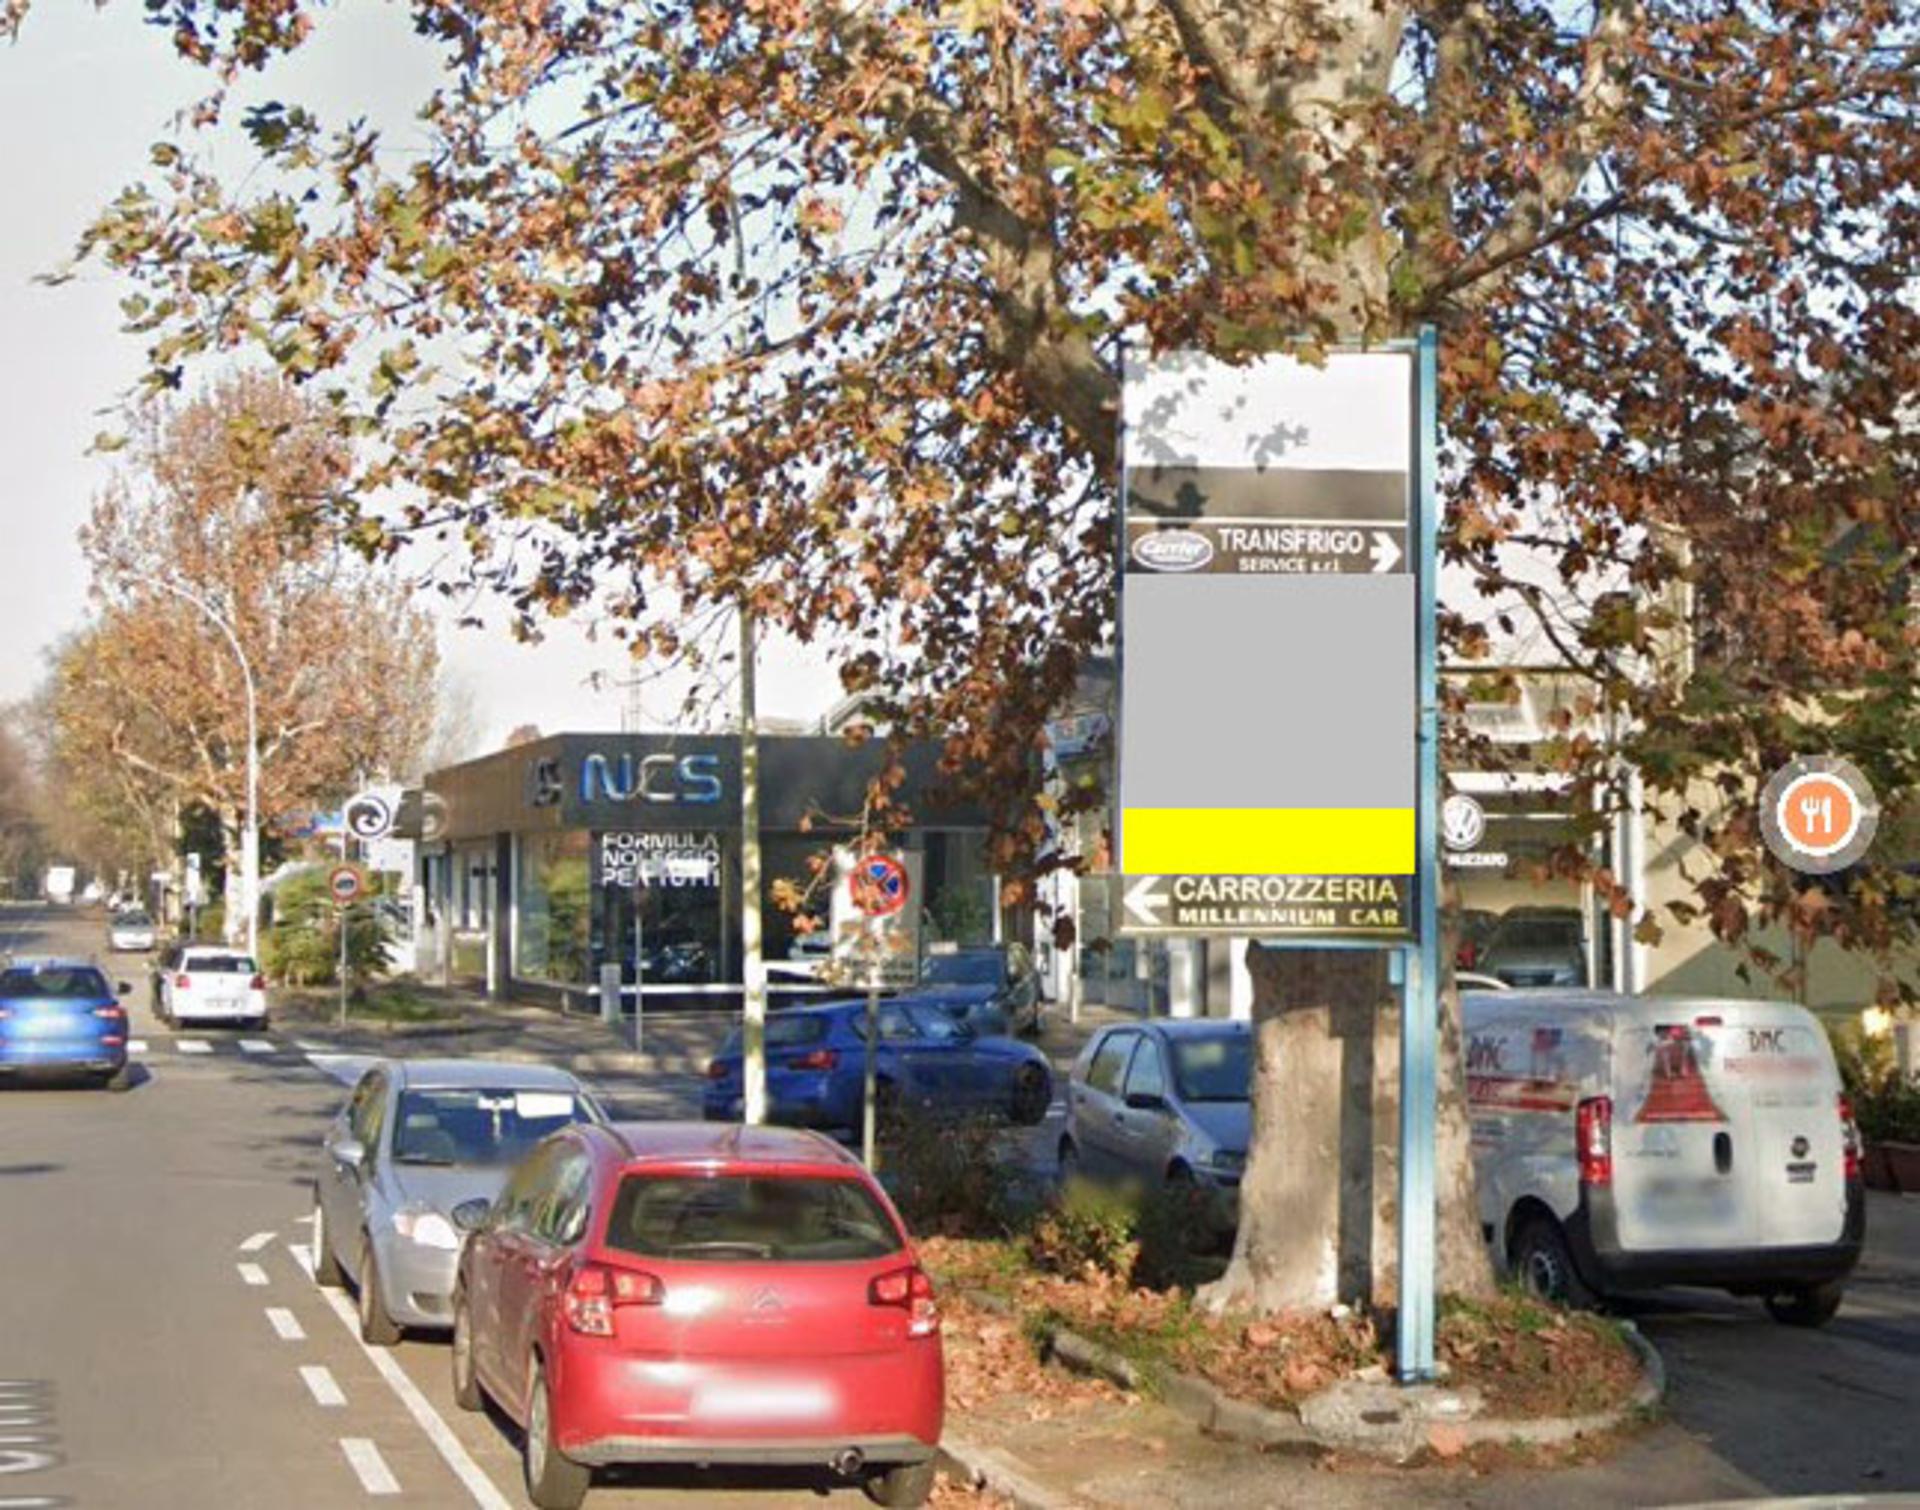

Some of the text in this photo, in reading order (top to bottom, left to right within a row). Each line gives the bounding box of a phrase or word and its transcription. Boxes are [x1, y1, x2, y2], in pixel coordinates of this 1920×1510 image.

[1217, 528, 1364, 553] TRANSFRIGO
[1239, 557, 1305, 572] SERVICE
[580, 753, 722, 802] NCS
[602, 832, 719, 849] FORMULA
[1173, 876, 1398, 902] CARROZZERIA
[1178, 907, 1399, 924] MILLENNIUM CAR
